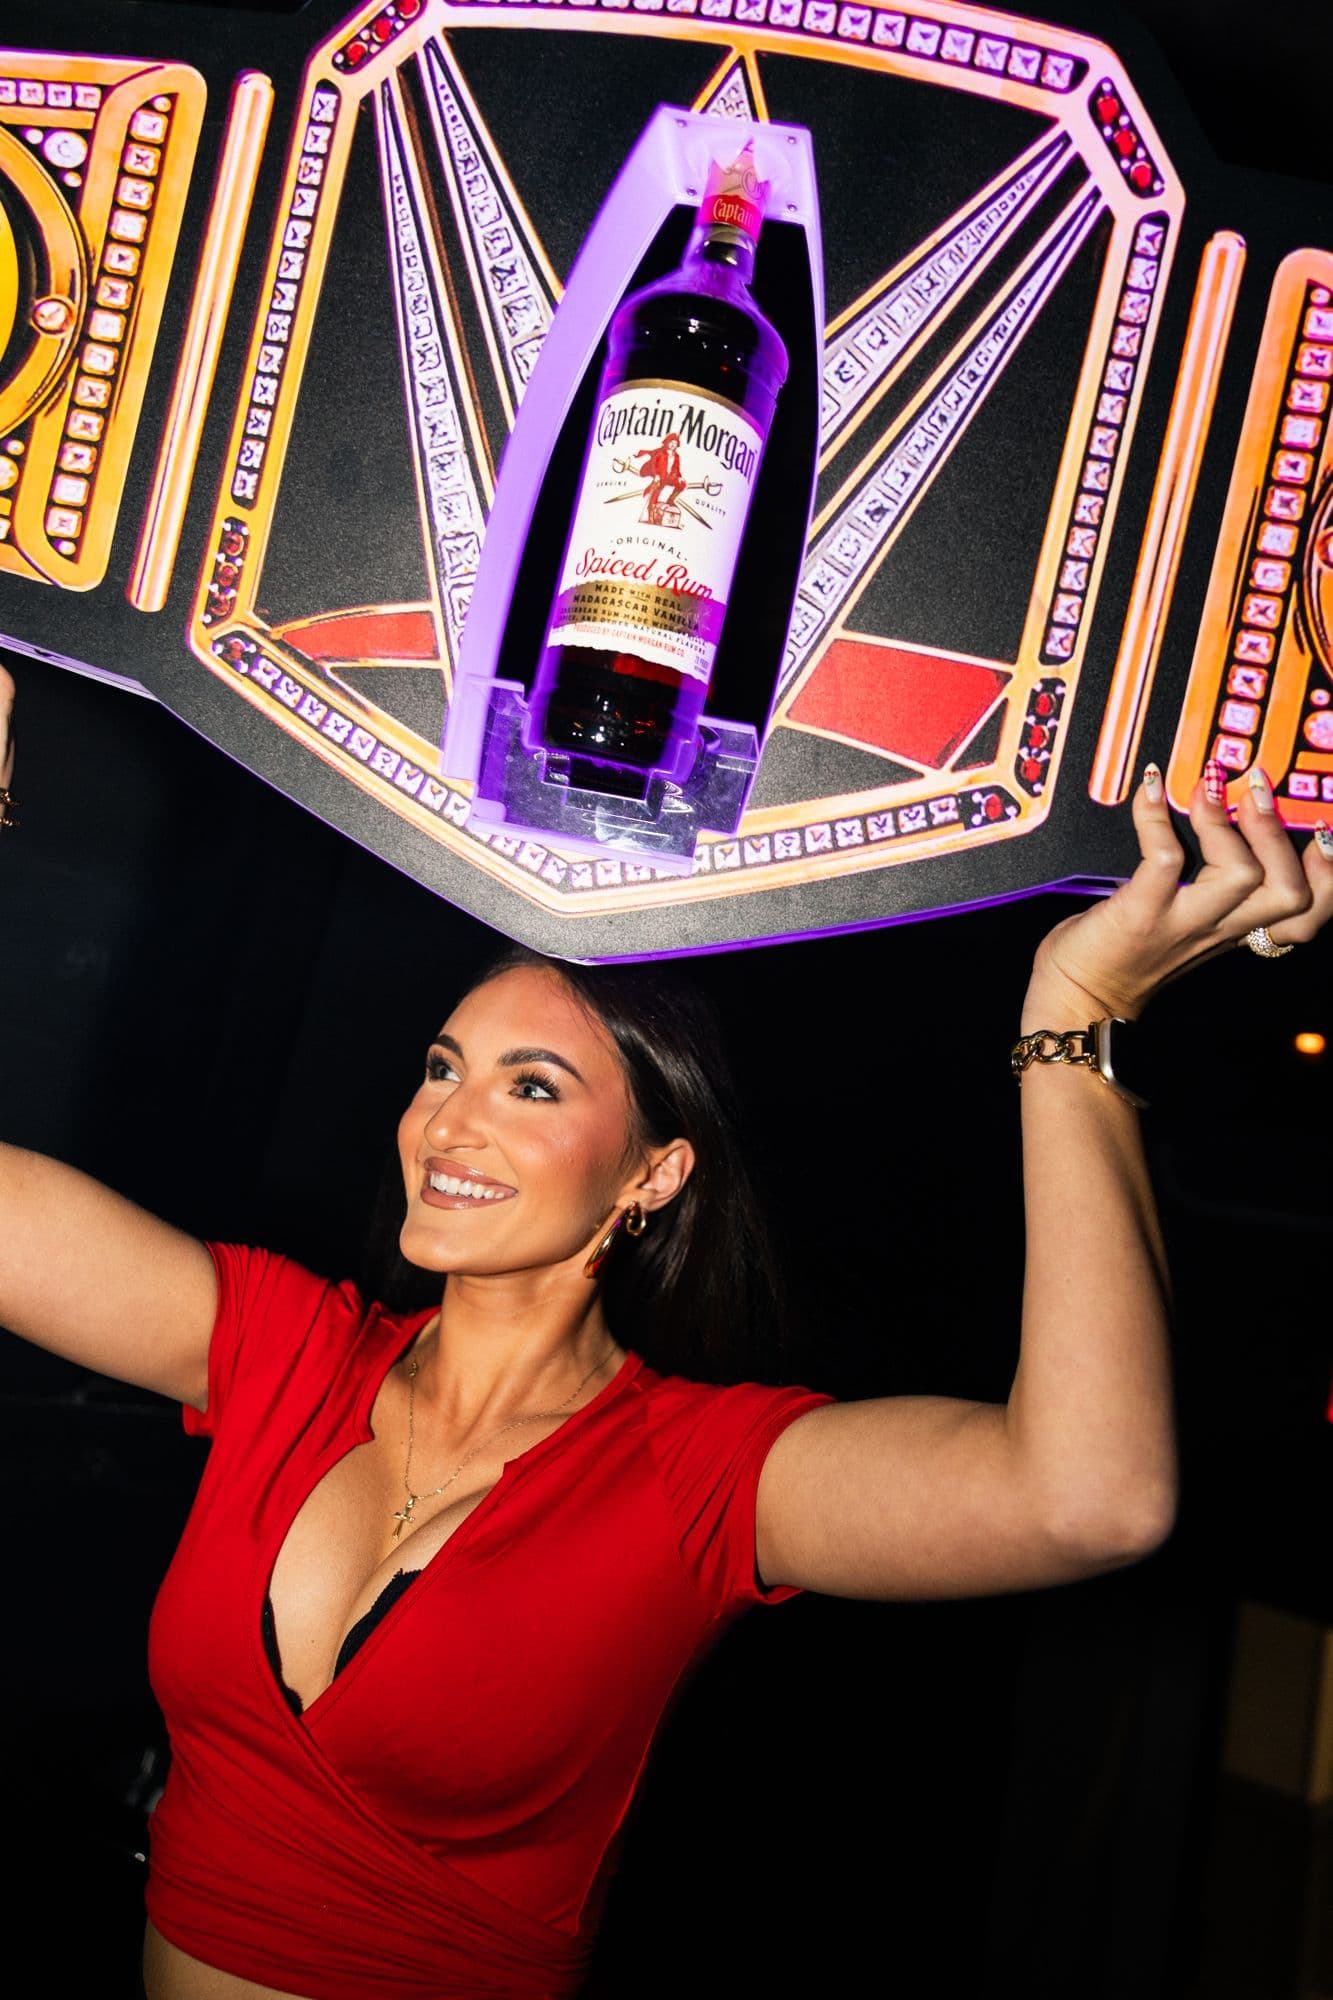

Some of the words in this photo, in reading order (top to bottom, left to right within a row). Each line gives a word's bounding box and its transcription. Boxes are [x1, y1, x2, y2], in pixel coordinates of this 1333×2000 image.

[713, 198, 753, 229] Captain
[597, 399, 674, 447] Captain
[679, 403, 757, 485] Morgan
[695, 498, 726, 517] QUALITY
[576, 548, 656, 582] Spiced
[657, 564, 713, 600] Rum
[595, 584, 624, 595] MADE
[630, 589, 651, 598] WITH
[655, 596, 682, 611] REAL
[573, 595, 648, 614] MADAGASCAR
[654, 608, 699, 631] VANILLA
[602, 609, 619, 617] RUM
[633, 624, 672, 640] NATURAL
